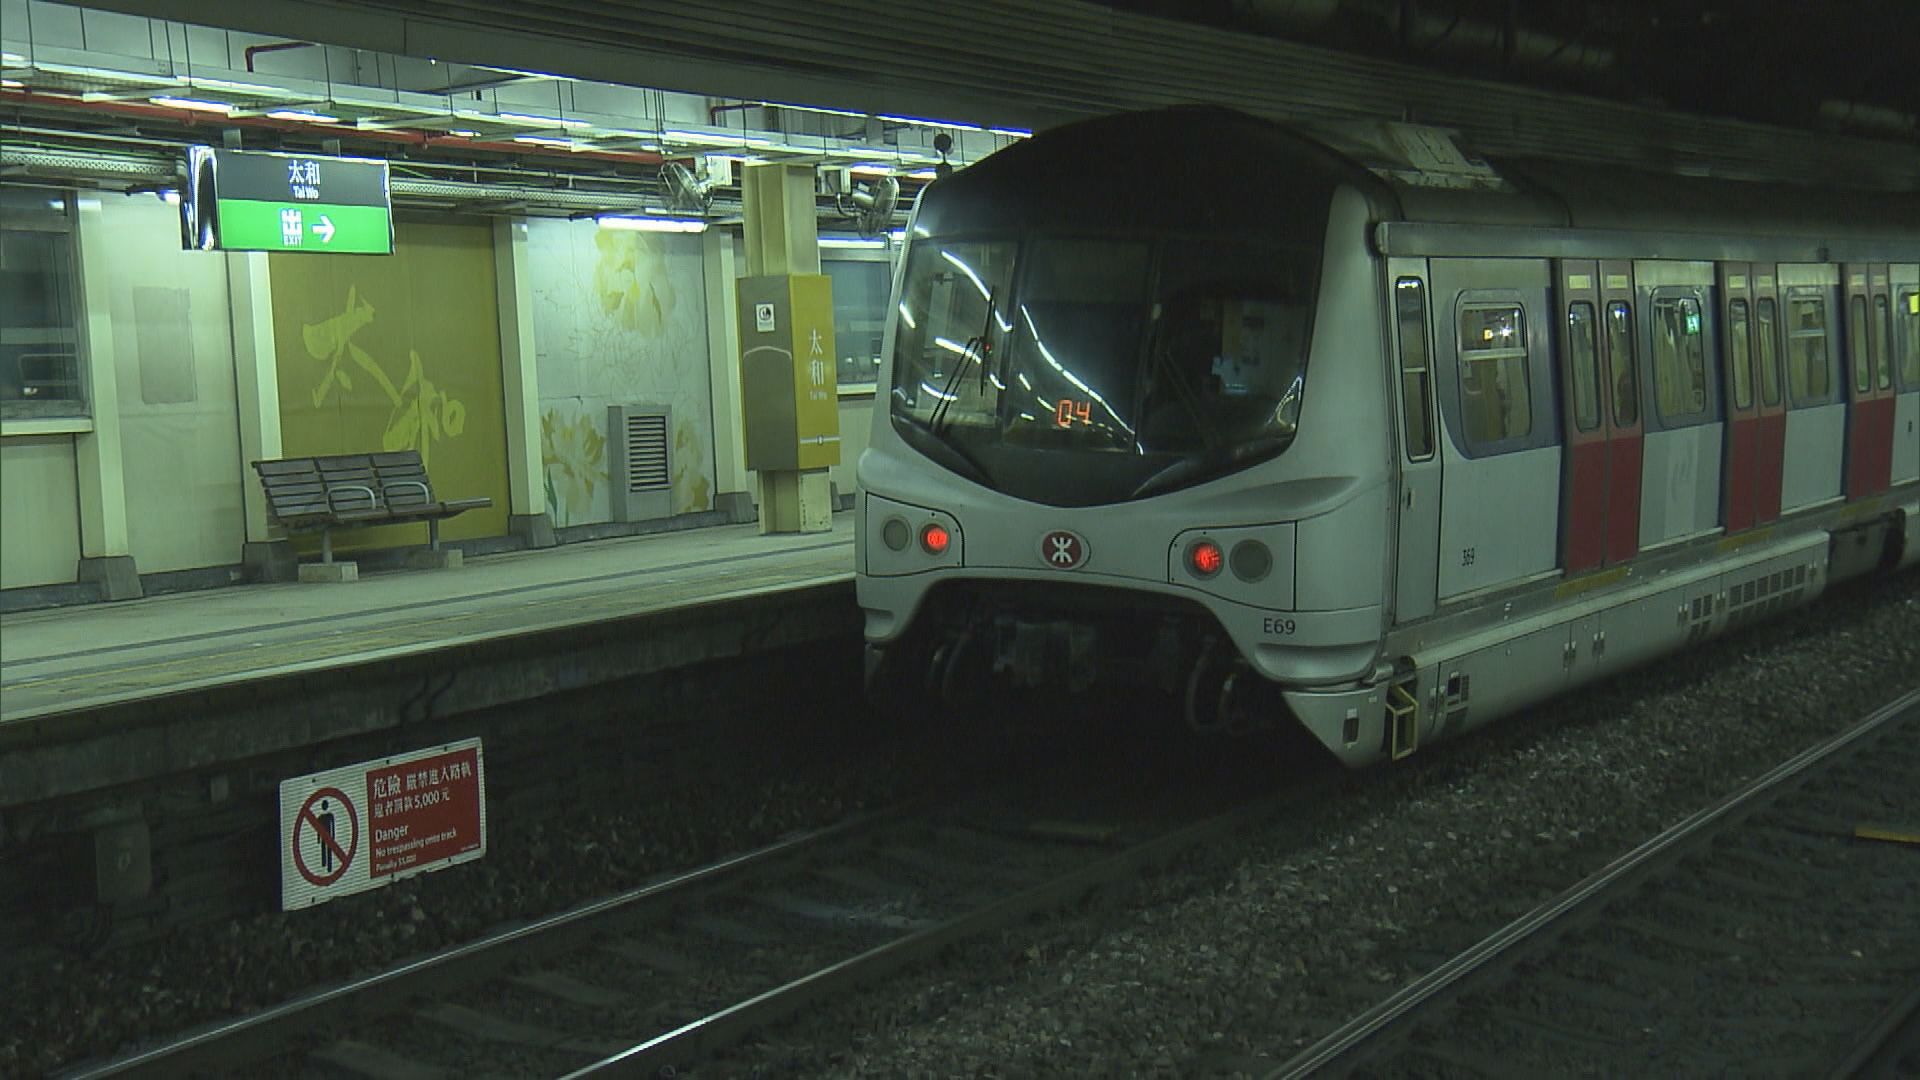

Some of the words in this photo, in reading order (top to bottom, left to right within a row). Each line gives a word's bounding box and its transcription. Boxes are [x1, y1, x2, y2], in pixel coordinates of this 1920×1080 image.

[288, 159, 321, 185] 太和
[293, 185, 305, 199] Tai
[306, 186, 319, 199] Wo
[281, 208, 303, 235] 出
[283, 235, 302, 248] EXIT
[807, 327, 824, 386] 太和
[1057, 399, 1091, 427] 04
[1461, 547, 1475, 567] 369
[1263, 617, 1296, 635] E69
[373, 773, 402, 800] 危險
[375, 825, 408, 843] Danger
[375, 847, 386, 859] No
[441, 826, 457, 841] track
